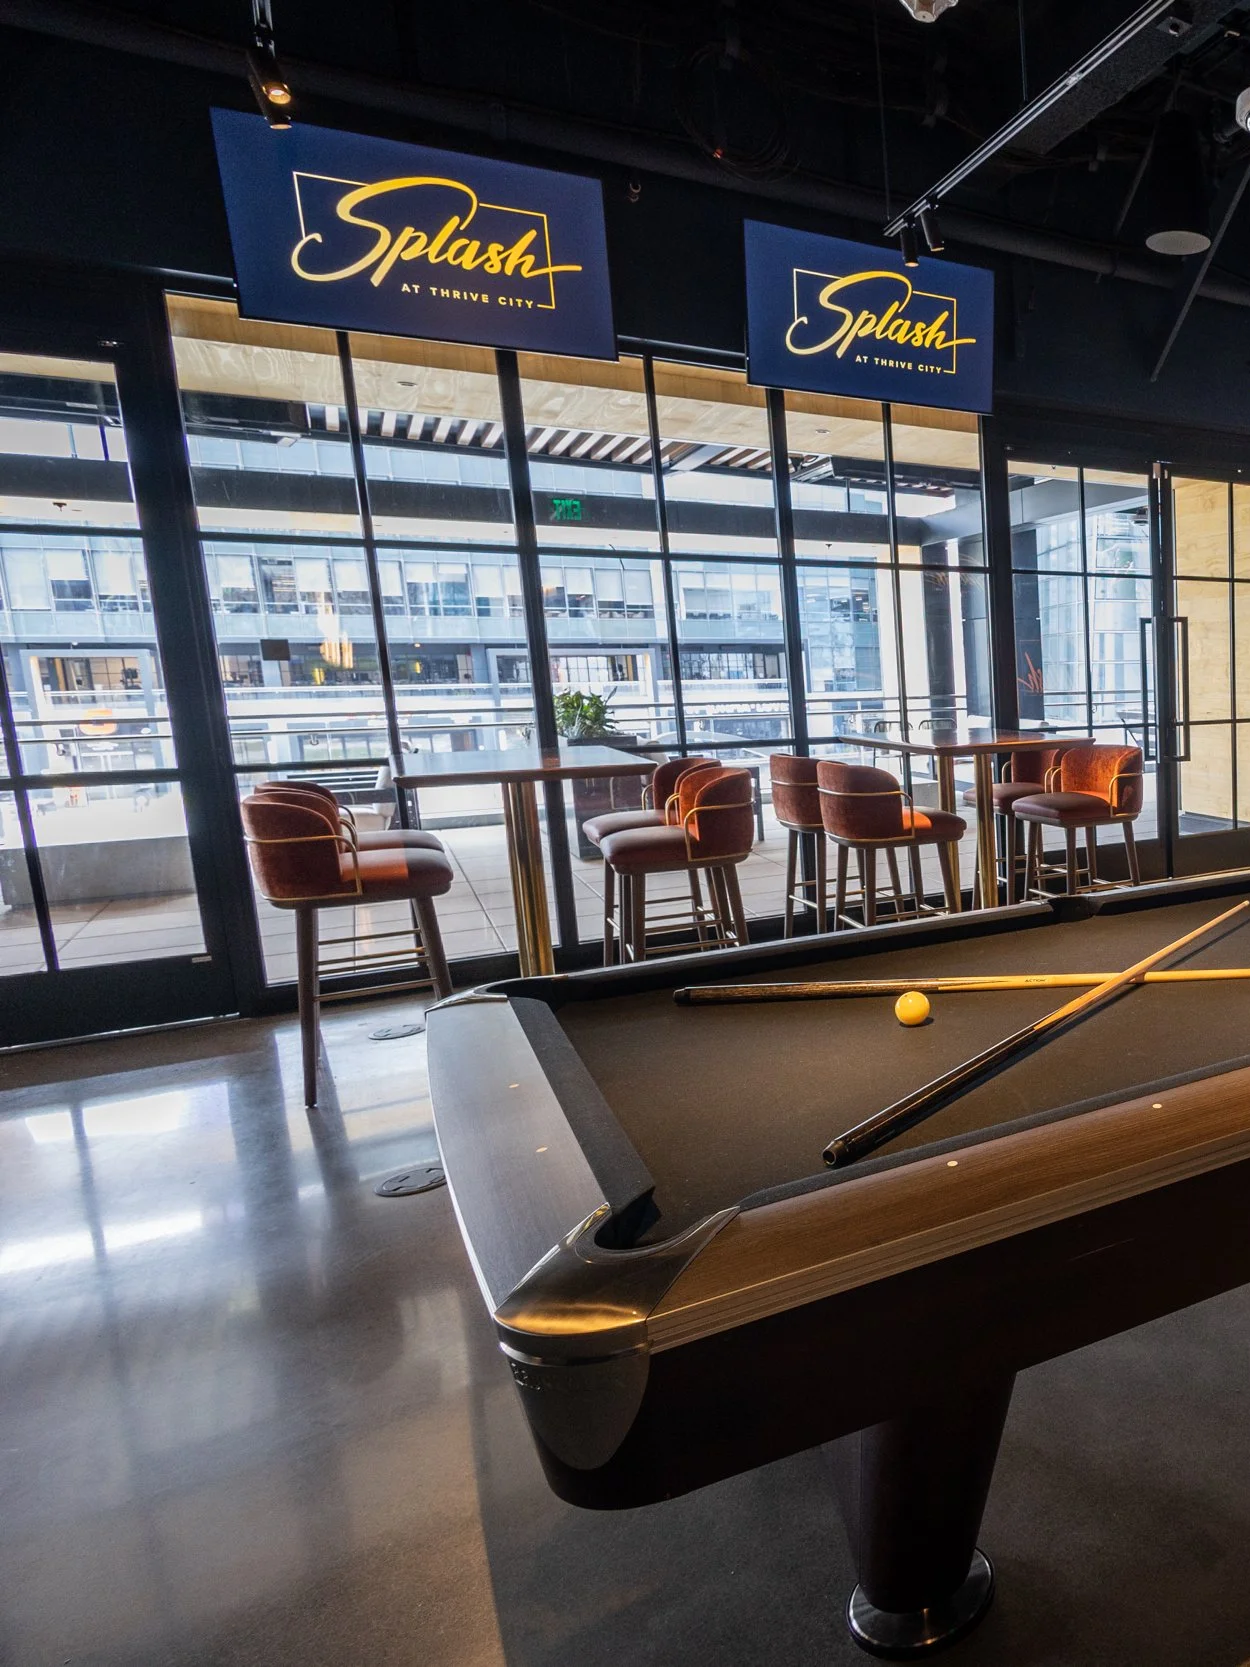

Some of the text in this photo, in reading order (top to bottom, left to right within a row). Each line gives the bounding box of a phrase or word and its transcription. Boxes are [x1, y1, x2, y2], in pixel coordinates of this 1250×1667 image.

[291, 176, 583, 288] Splash
[401, 283, 534, 309] AT THRIVE CITY
[785, 270, 977, 358] Splash
[855, 354, 942, 374] AT THRIVE CITY
